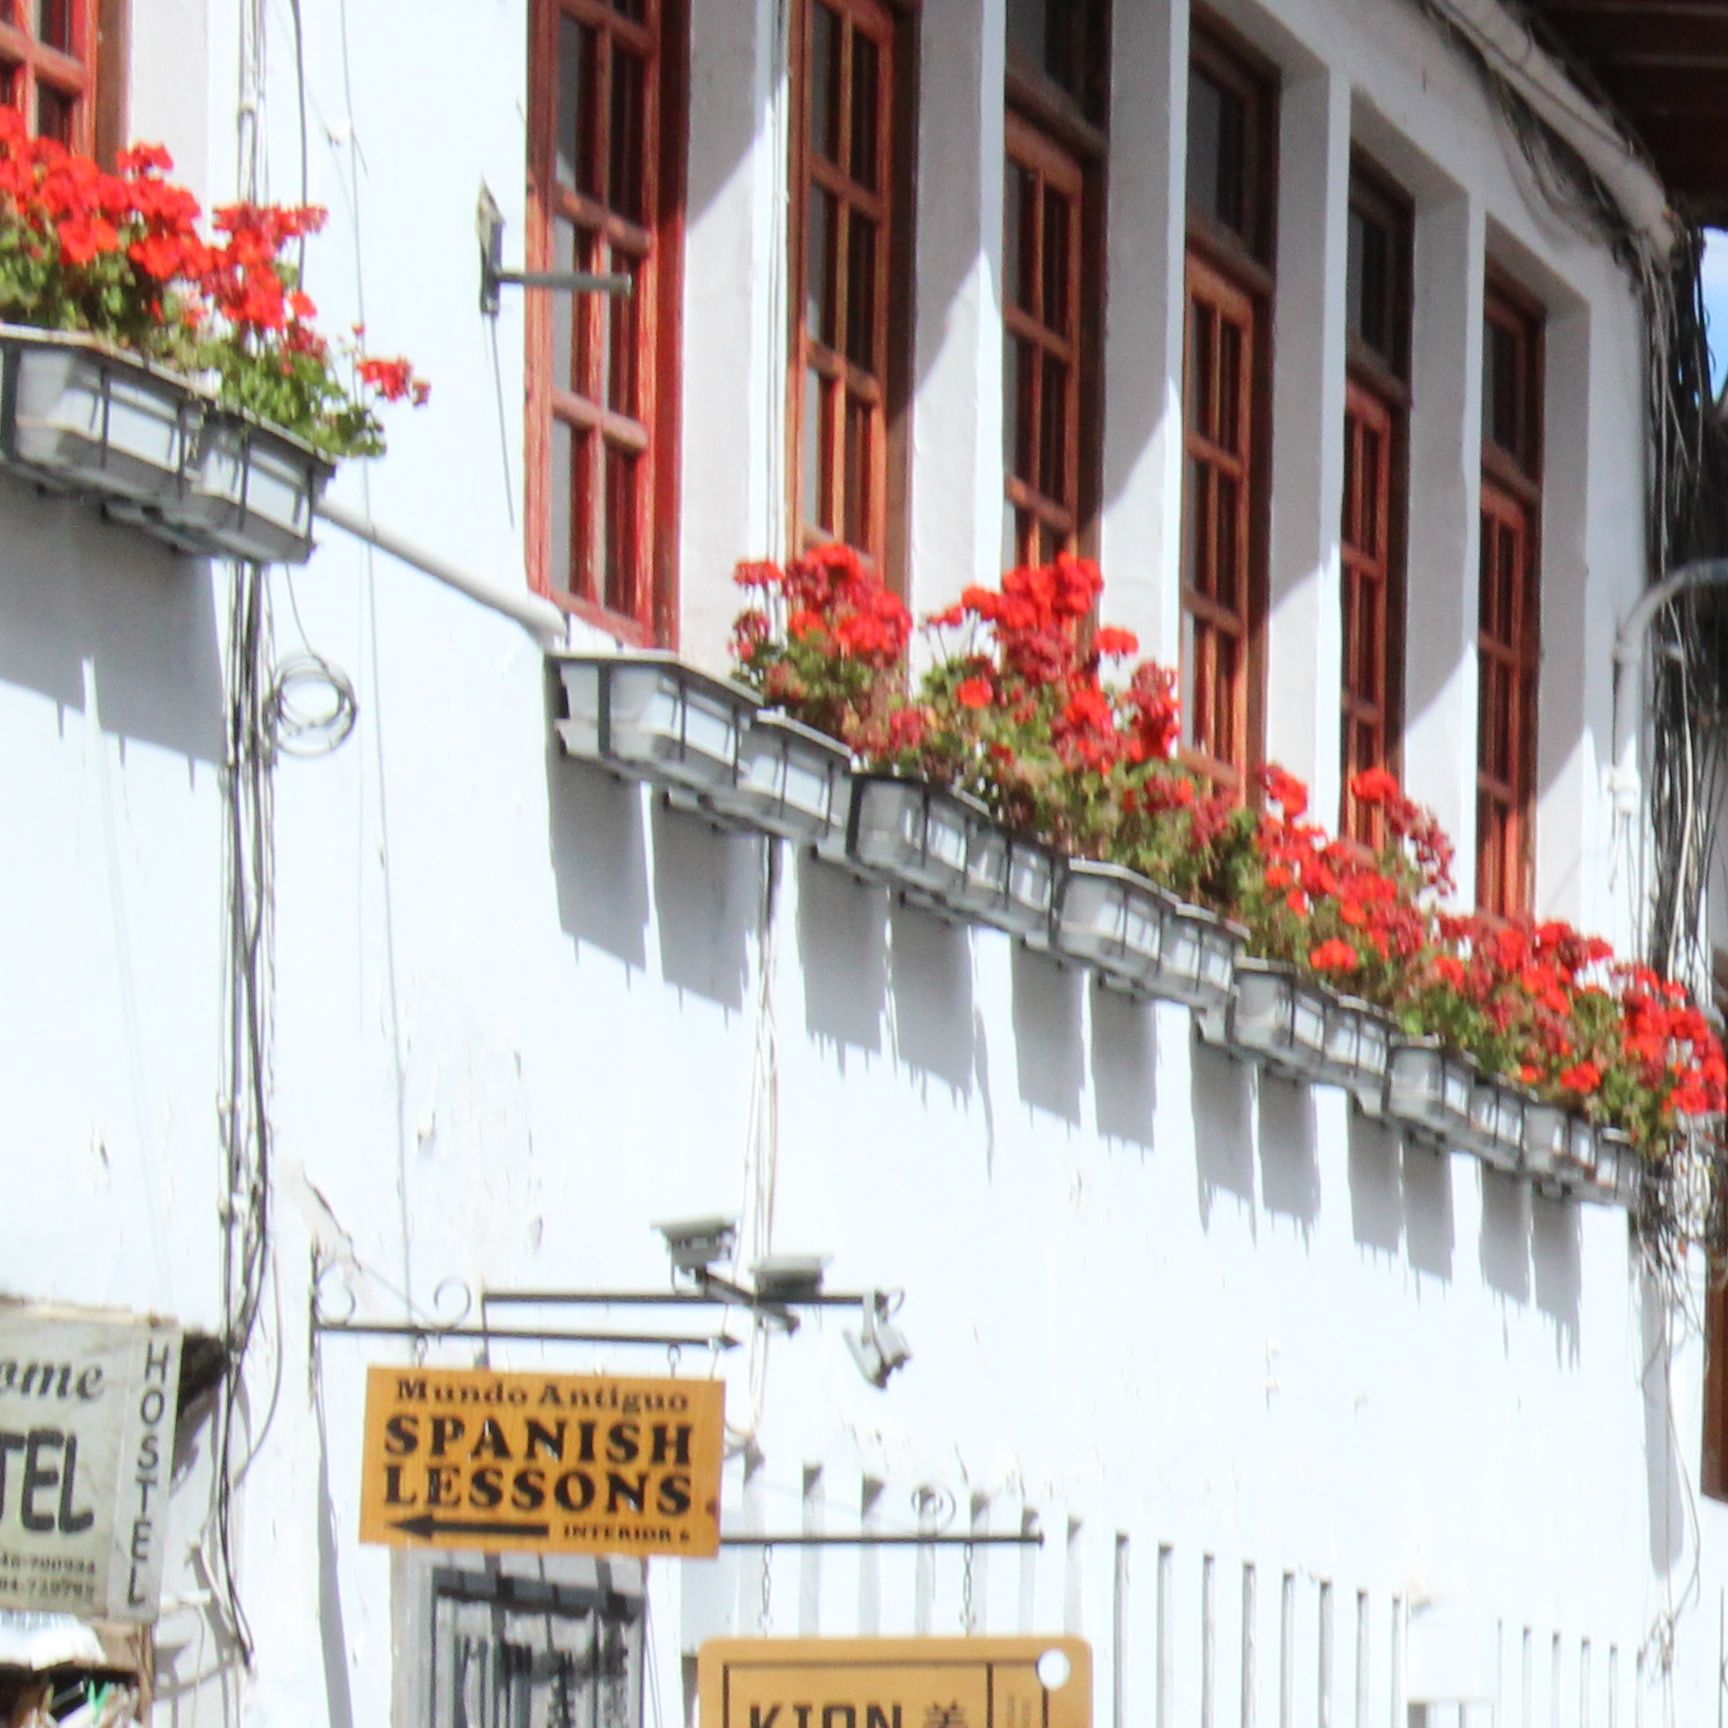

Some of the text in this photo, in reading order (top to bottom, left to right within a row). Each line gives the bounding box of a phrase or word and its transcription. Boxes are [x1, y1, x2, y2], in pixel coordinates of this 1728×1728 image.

[397, 1377, 690, 1414] Mundo Antiguo
[384, 1412, 693, 1465] SPANISH
[128, 1341, 169, 1608] HOSTEL
[384, 1463, 692, 1516] LESSONS
[564, 1522, 672, 1543] INTERIOR
